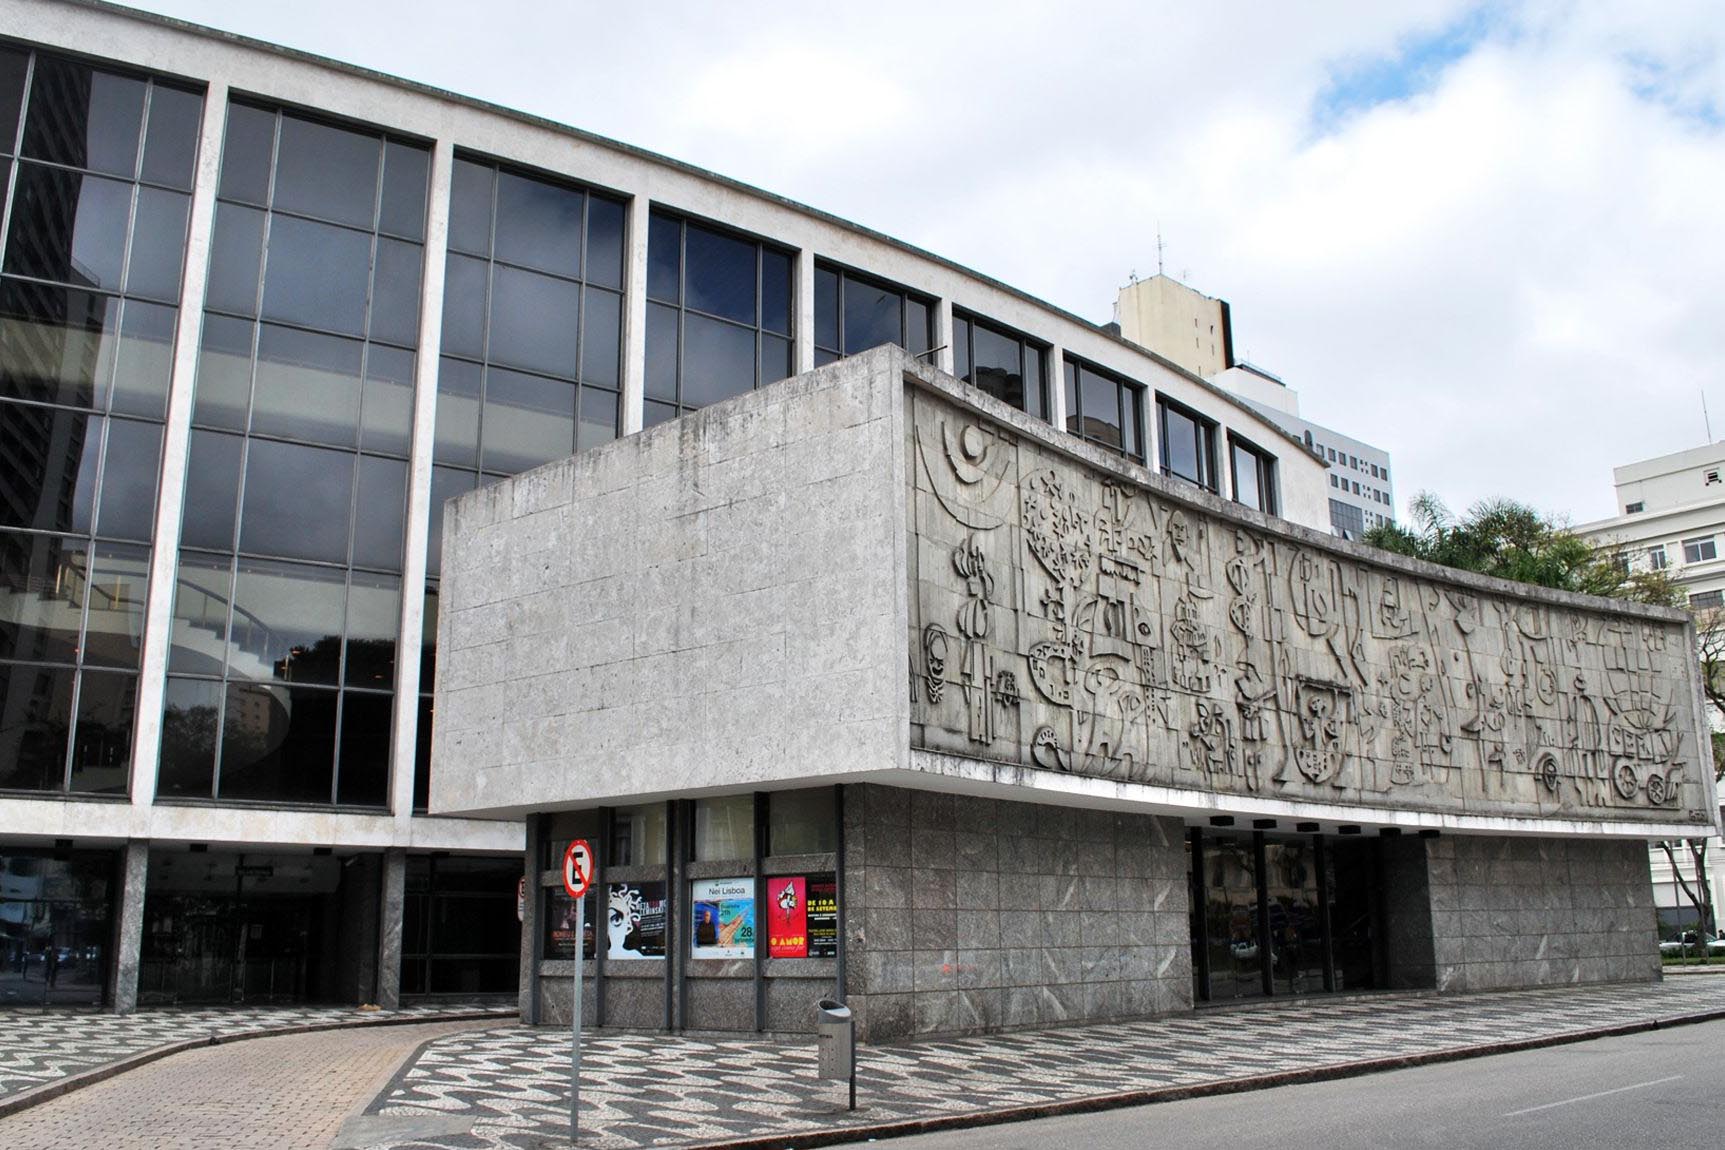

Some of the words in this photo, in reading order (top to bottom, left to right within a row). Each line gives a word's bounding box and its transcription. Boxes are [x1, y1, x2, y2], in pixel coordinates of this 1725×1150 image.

[708, 887, 720, 895] Nei
[722, 887, 745, 895] Lisboa
[741, 926, 753, 938] 28
[770, 937, 777, 946] O
[779, 936, 805, 946] AMOR
